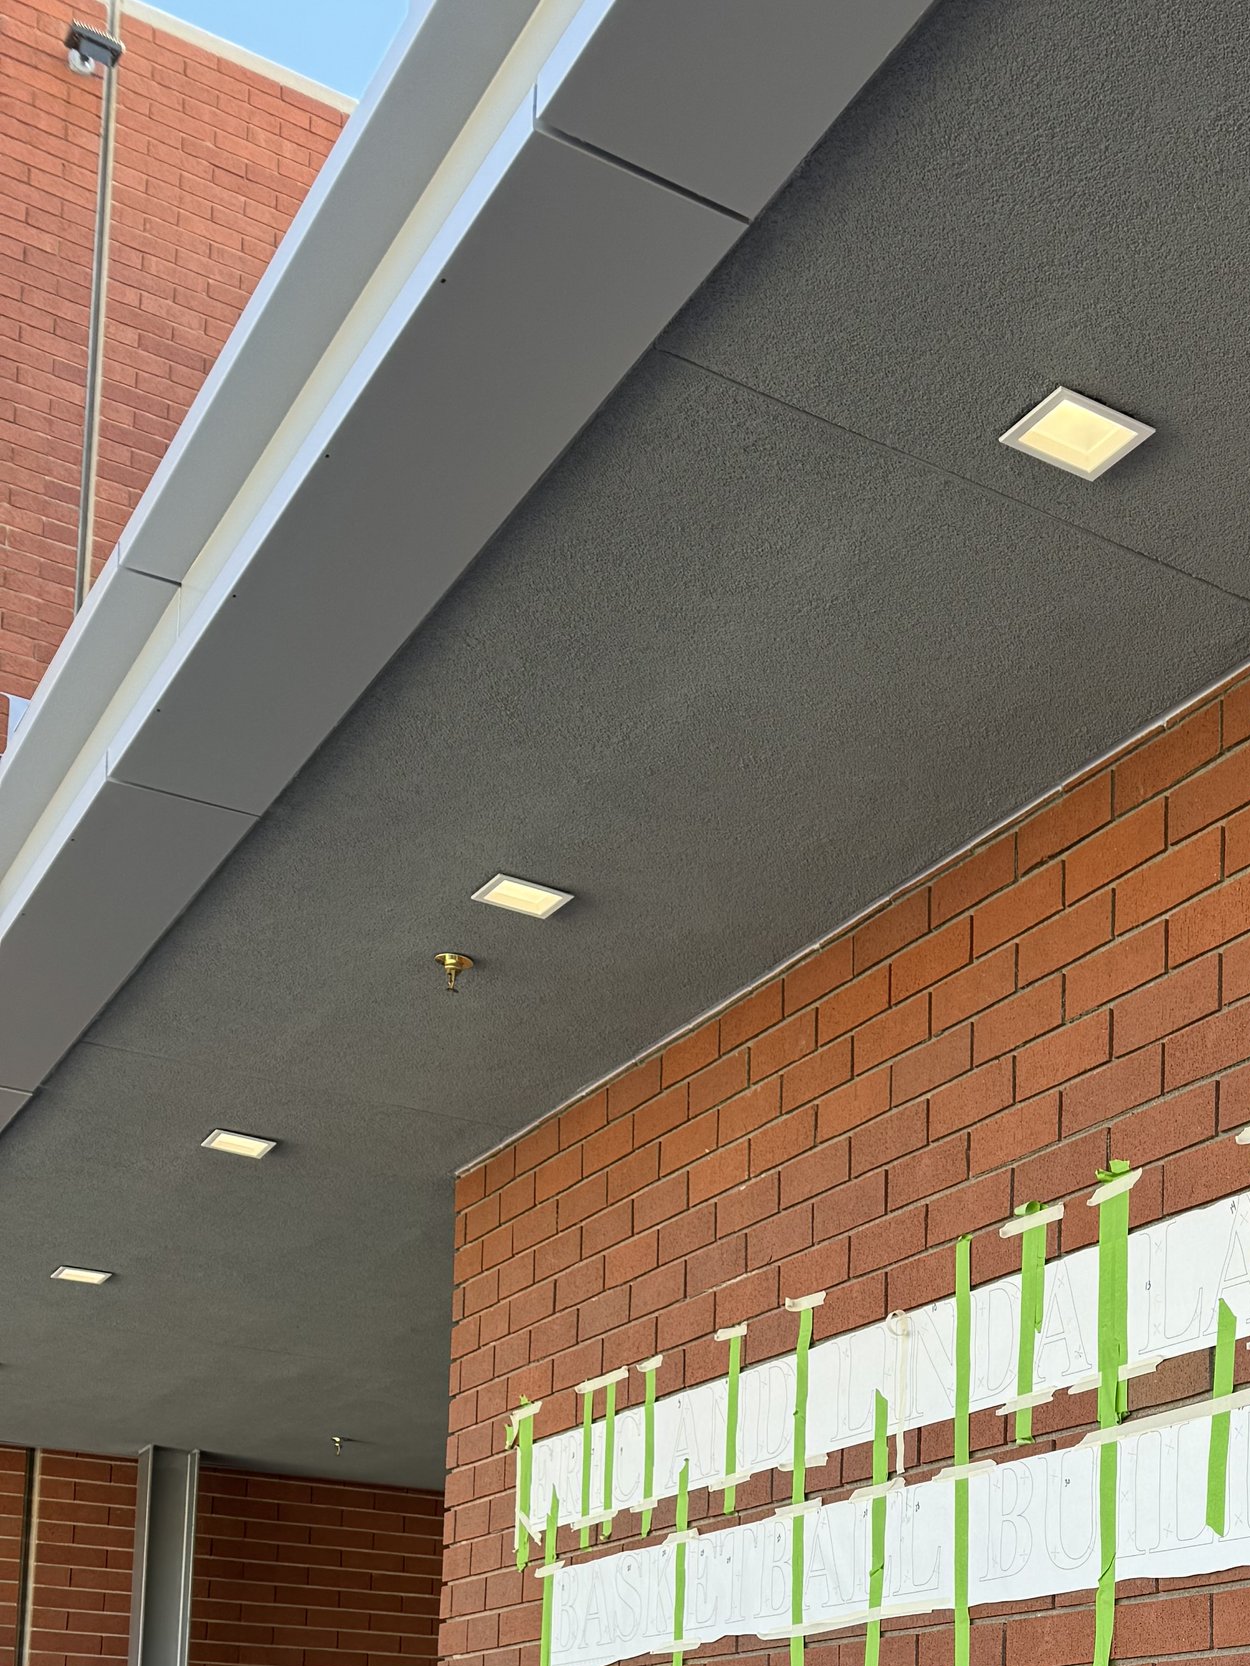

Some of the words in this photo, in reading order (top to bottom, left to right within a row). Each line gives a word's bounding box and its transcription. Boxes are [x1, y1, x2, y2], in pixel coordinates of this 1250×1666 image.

[529, 1409, 643, 1529] ERIC
[664, 1358, 797, 1491] AND
[829, 1258, 1094, 1443] LINDA
[551, 1484, 943, 1655] BASKETBALL
